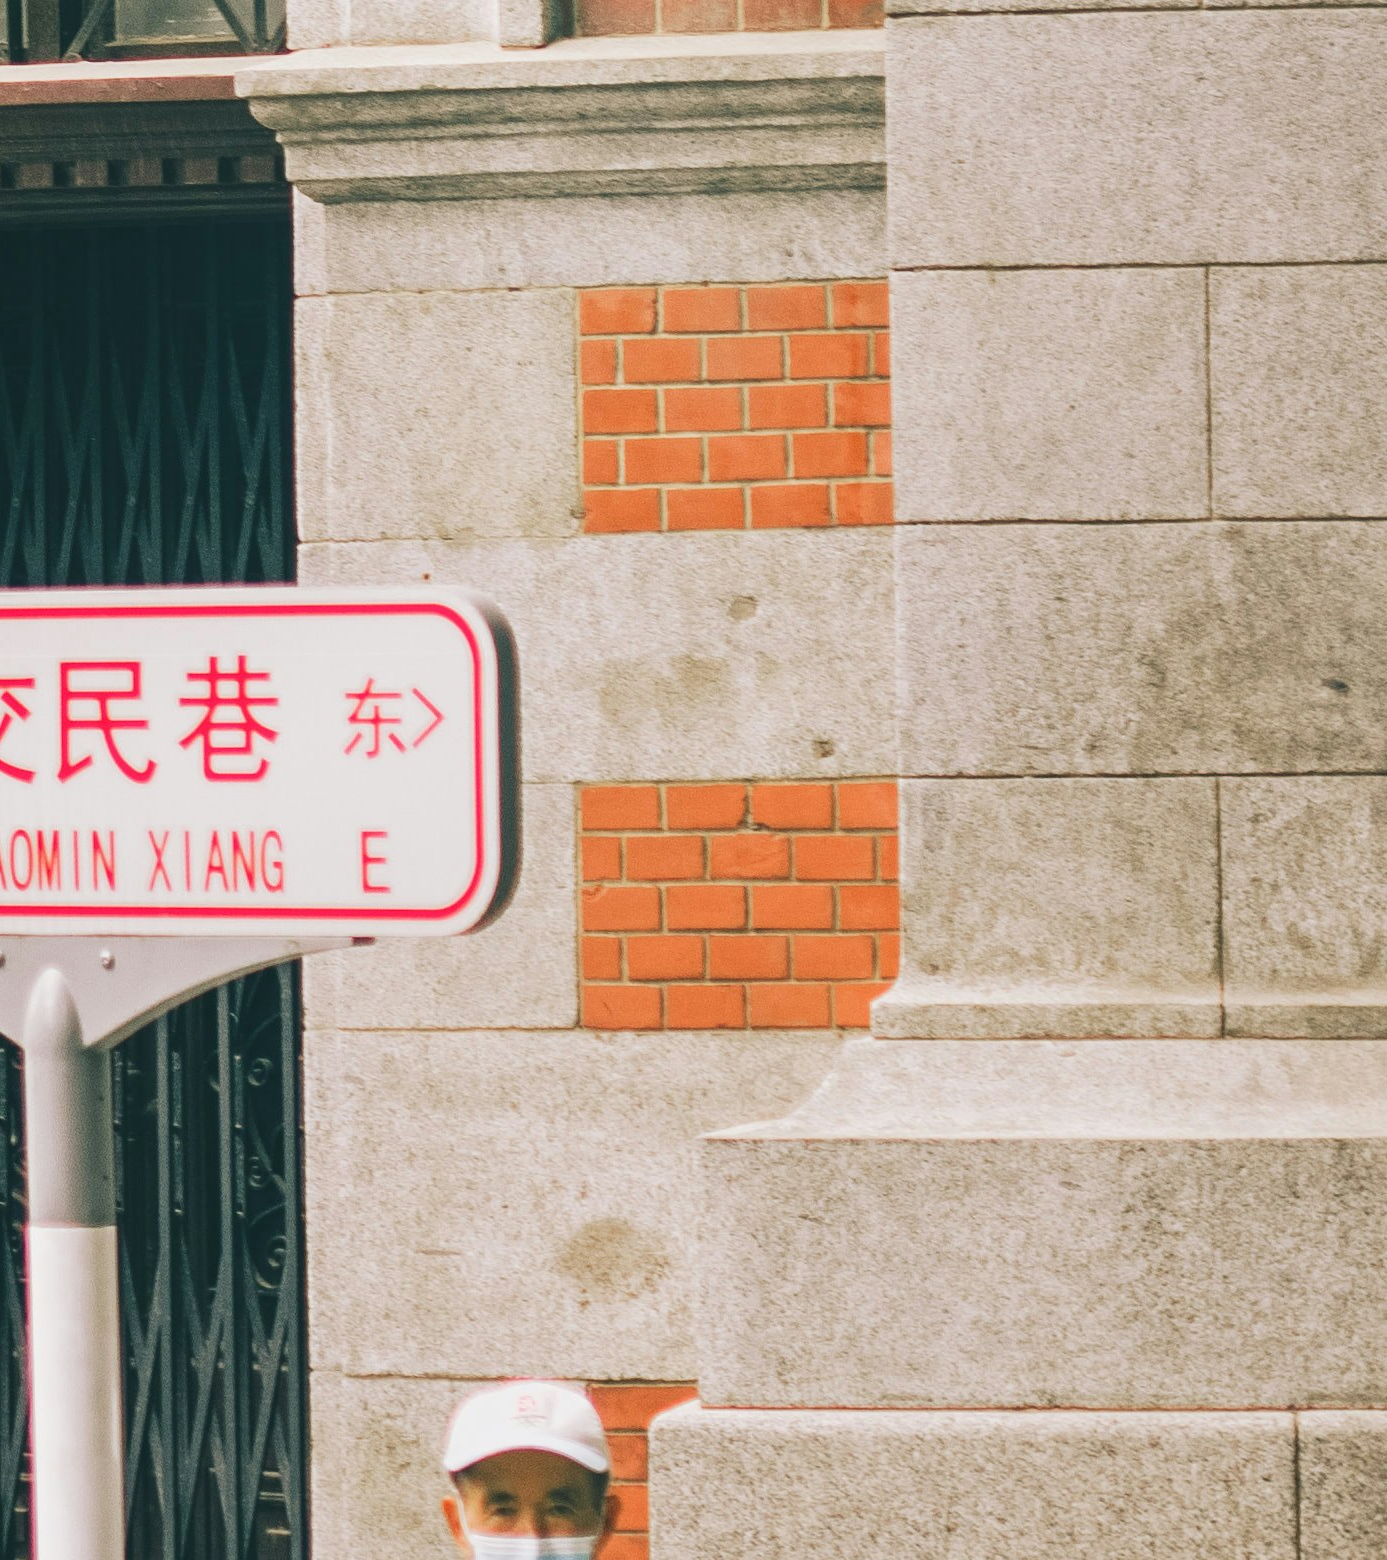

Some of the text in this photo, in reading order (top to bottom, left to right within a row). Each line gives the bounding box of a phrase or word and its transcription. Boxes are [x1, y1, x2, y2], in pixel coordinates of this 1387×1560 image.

[343, 677, 406, 759] 东
[148, 829, 285, 893] XIANG
[360, 831, 391, 894] E
